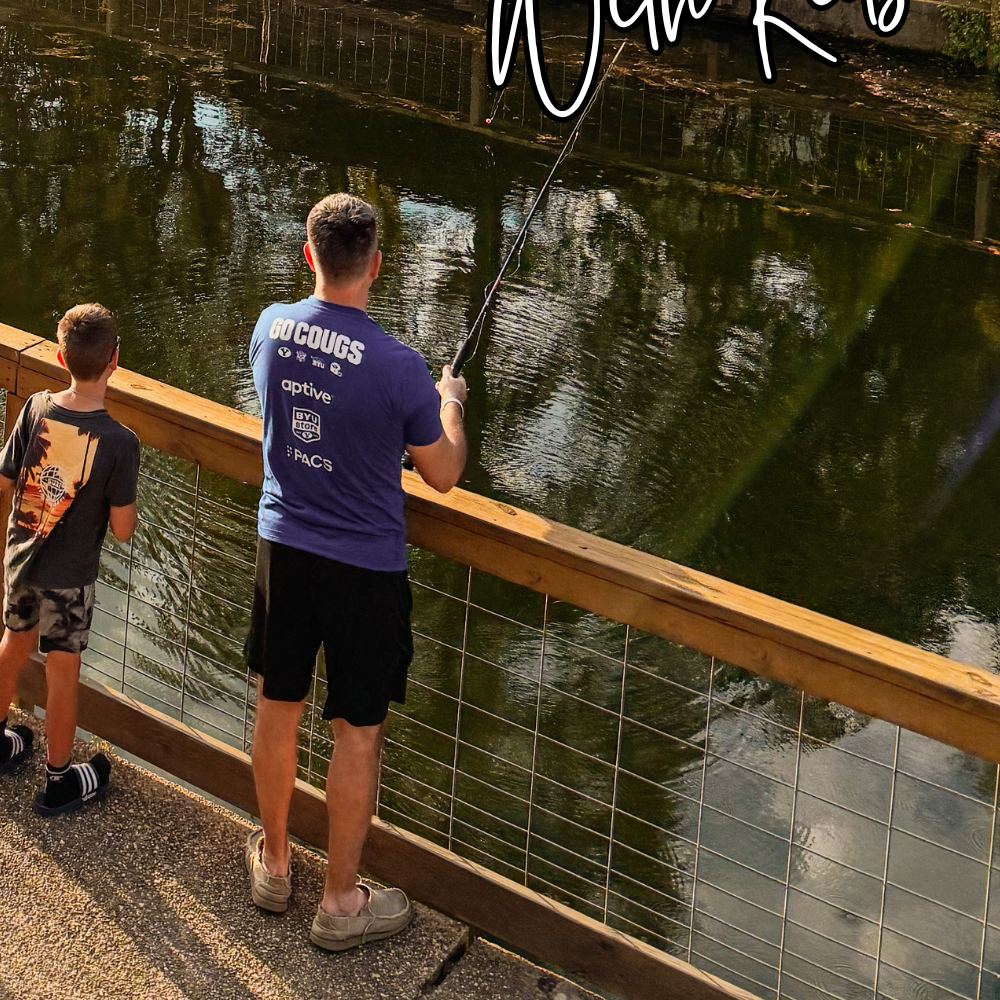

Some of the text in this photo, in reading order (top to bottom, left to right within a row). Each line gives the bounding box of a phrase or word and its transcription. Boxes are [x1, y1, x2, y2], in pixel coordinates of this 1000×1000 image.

[269, 317, 365, 365] GO COUGS
[281, 379, 332, 404] aptive
[295, 421, 318, 432] store
[296, 412, 318, 424] BYU
[294, 448, 333, 472] PACS
